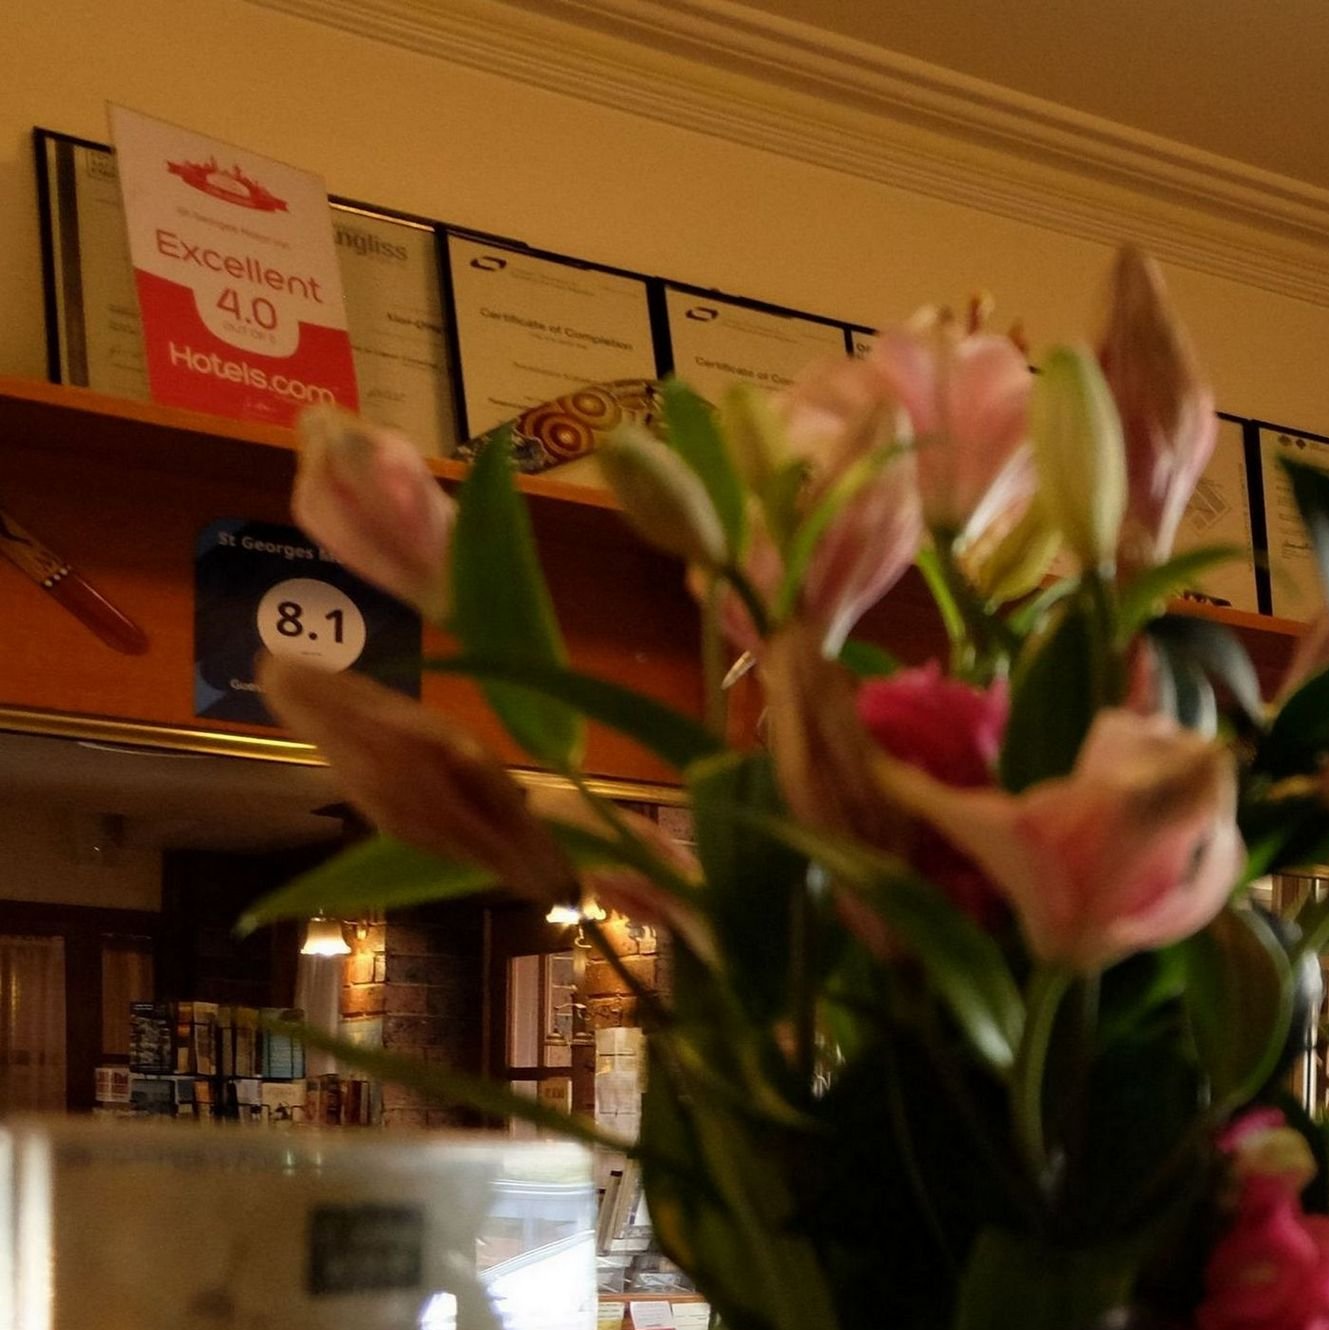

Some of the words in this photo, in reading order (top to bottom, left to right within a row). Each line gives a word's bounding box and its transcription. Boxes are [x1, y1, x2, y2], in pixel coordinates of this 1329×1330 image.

[335, 226, 408, 261] ngliss
[156, 229, 323, 304] Excellent
[216, 287, 279, 331] 4.0
[169, 341, 336, 407] Hotels.com
[217, 531, 236, 547] St
[241, 536, 314, 560] Georges
[276, 601, 344, 644] 8.1
